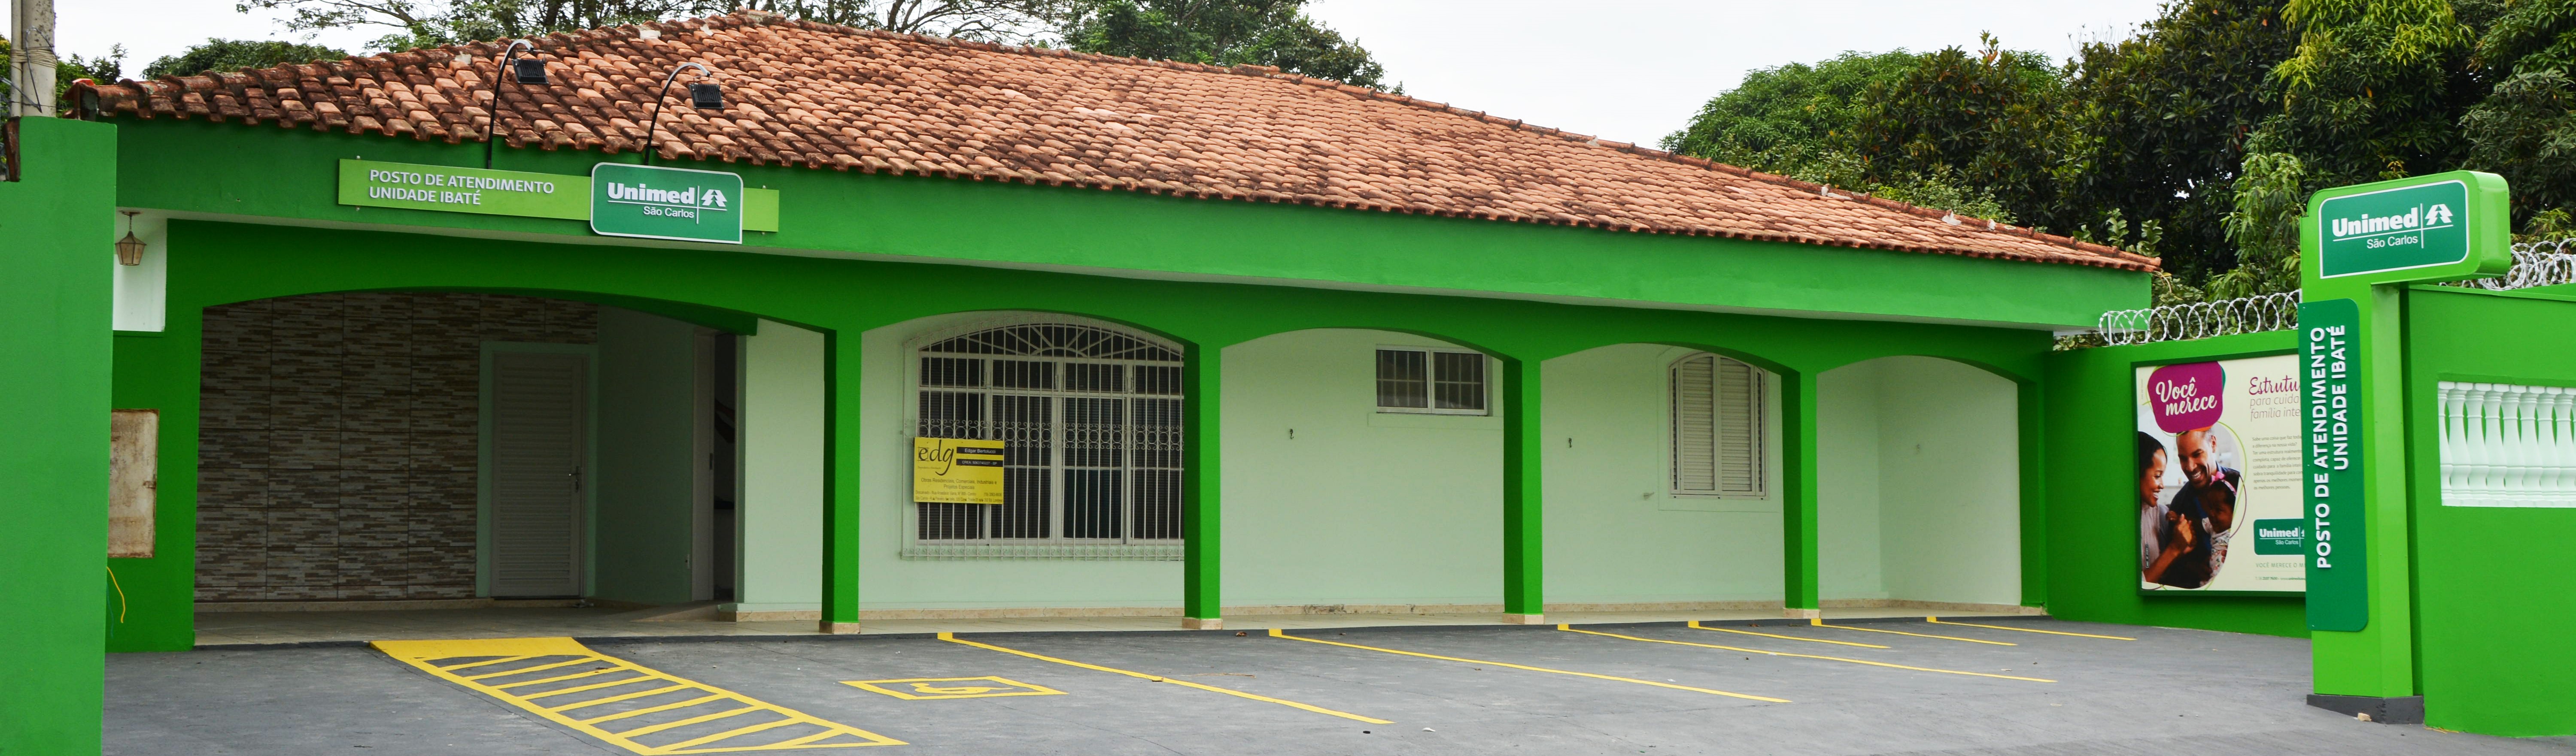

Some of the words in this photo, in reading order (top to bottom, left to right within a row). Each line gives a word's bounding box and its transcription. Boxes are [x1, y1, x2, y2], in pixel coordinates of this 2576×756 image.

[370, 169, 421, 184] POSTO
[425, 173, 444, 186] DE
[447, 175, 554, 194] ATENDIMENTO
[607, 181, 695, 204] Unimed
[369, 186, 437, 202] UNIDADE
[440, 190, 481, 205] IBATÉ
[644, 206, 662, 215] São
[665, 208, 694, 218] Carlos
[2332, 207, 2418, 237] Unimed
[2366, 238, 2385, 249] São
[2387, 235, 2418, 246] Carlos
[2325, 325, 2346, 378] IBATÉ
[2156, 377, 2197, 402] Você
[2250, 397, 2271, 409] para
[2274, 393, 2299, 405] cuida
[2310, 327, 2329, 469] ATENDIMENTO
[2166, 395, 2217, 416] merece
[2251, 407, 2281, 422] família
[2331, 384, 2349, 470] UNIDADE
[918, 439, 954, 476] edg
[2314, 473, 2329, 498] DE
[2259, 527, 2299, 538] Unimed
[2315, 503, 2332, 569] POSTO
